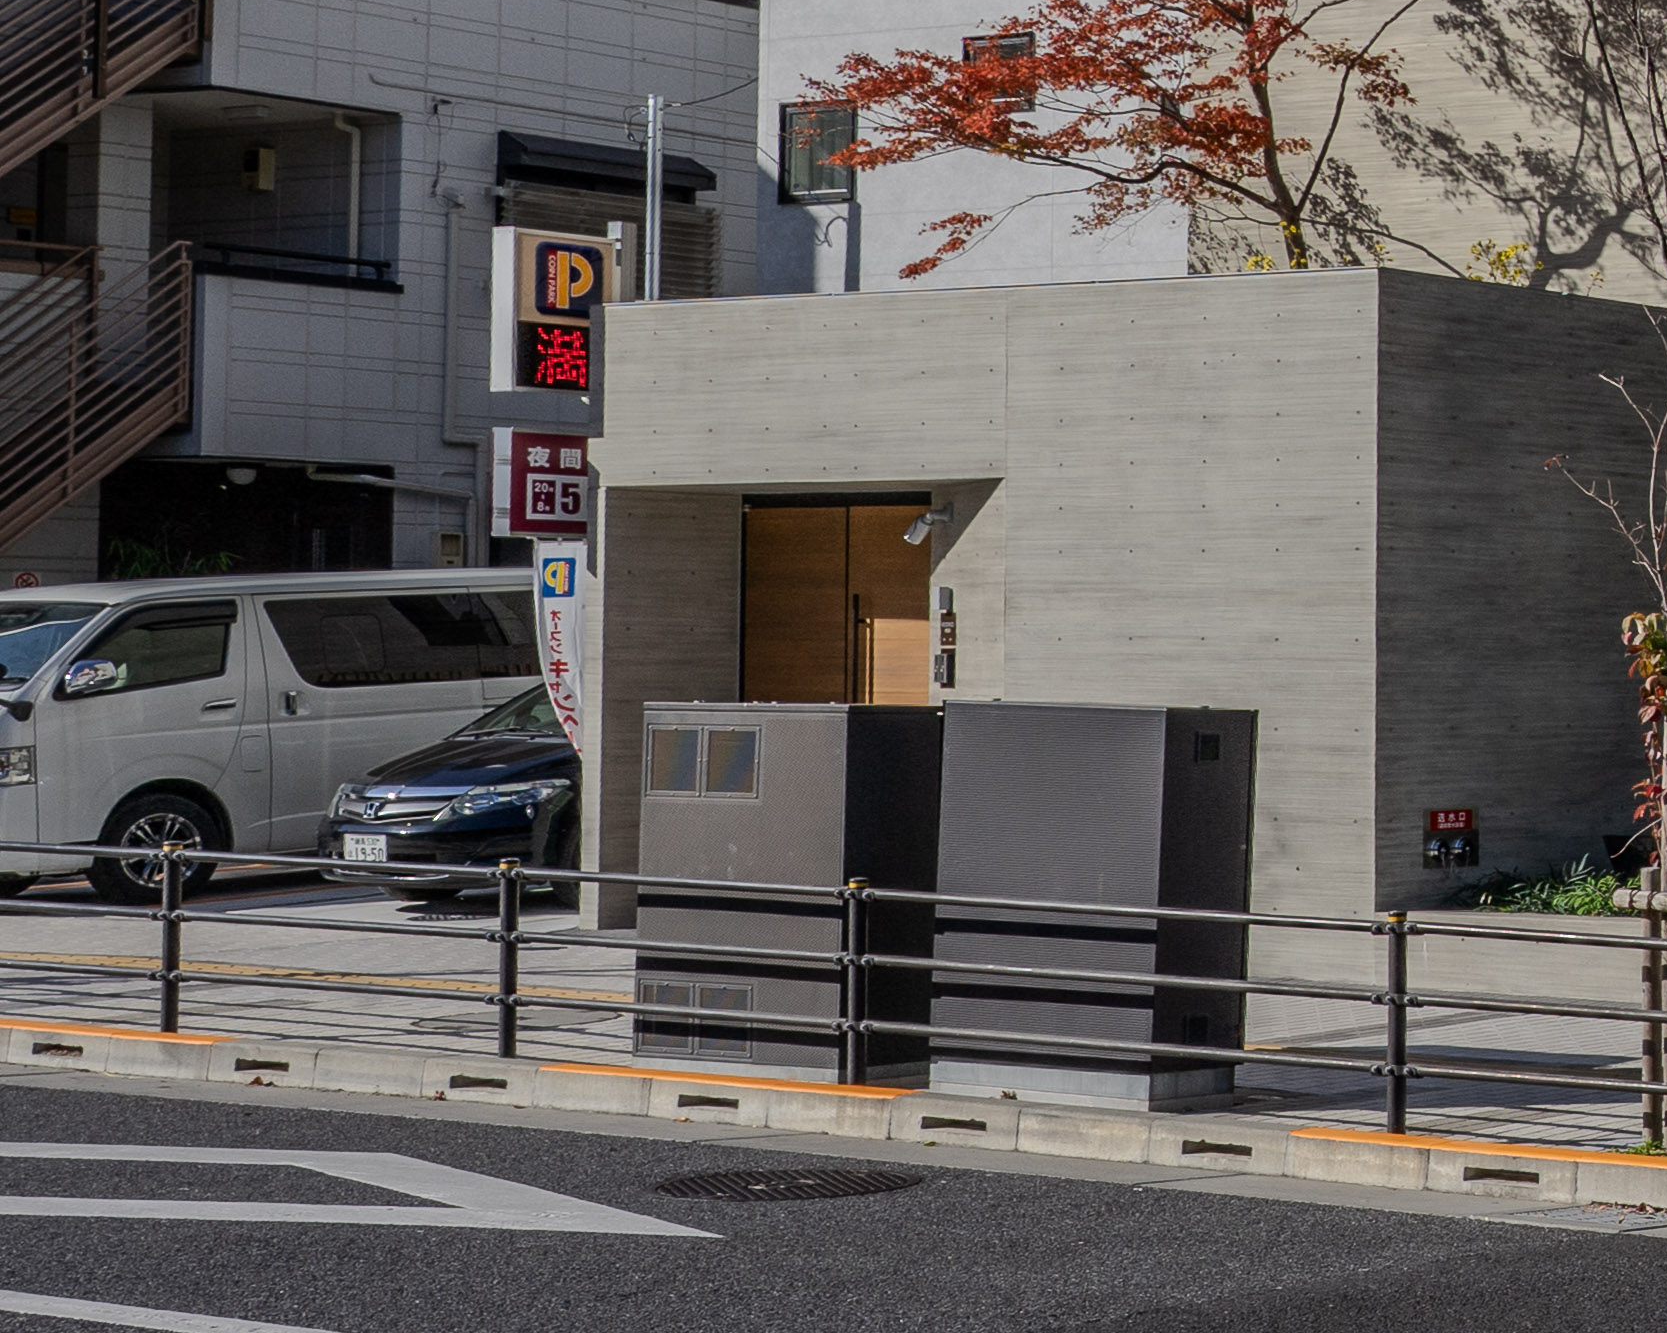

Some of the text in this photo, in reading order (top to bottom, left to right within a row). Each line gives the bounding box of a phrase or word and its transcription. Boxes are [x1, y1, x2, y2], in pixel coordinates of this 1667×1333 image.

[548, 254, 557, 305] COIN PARK
[556, 251, 594, 309] P
[527, 446, 582, 469] 夜間
[560, 482, 581, 515] 5
